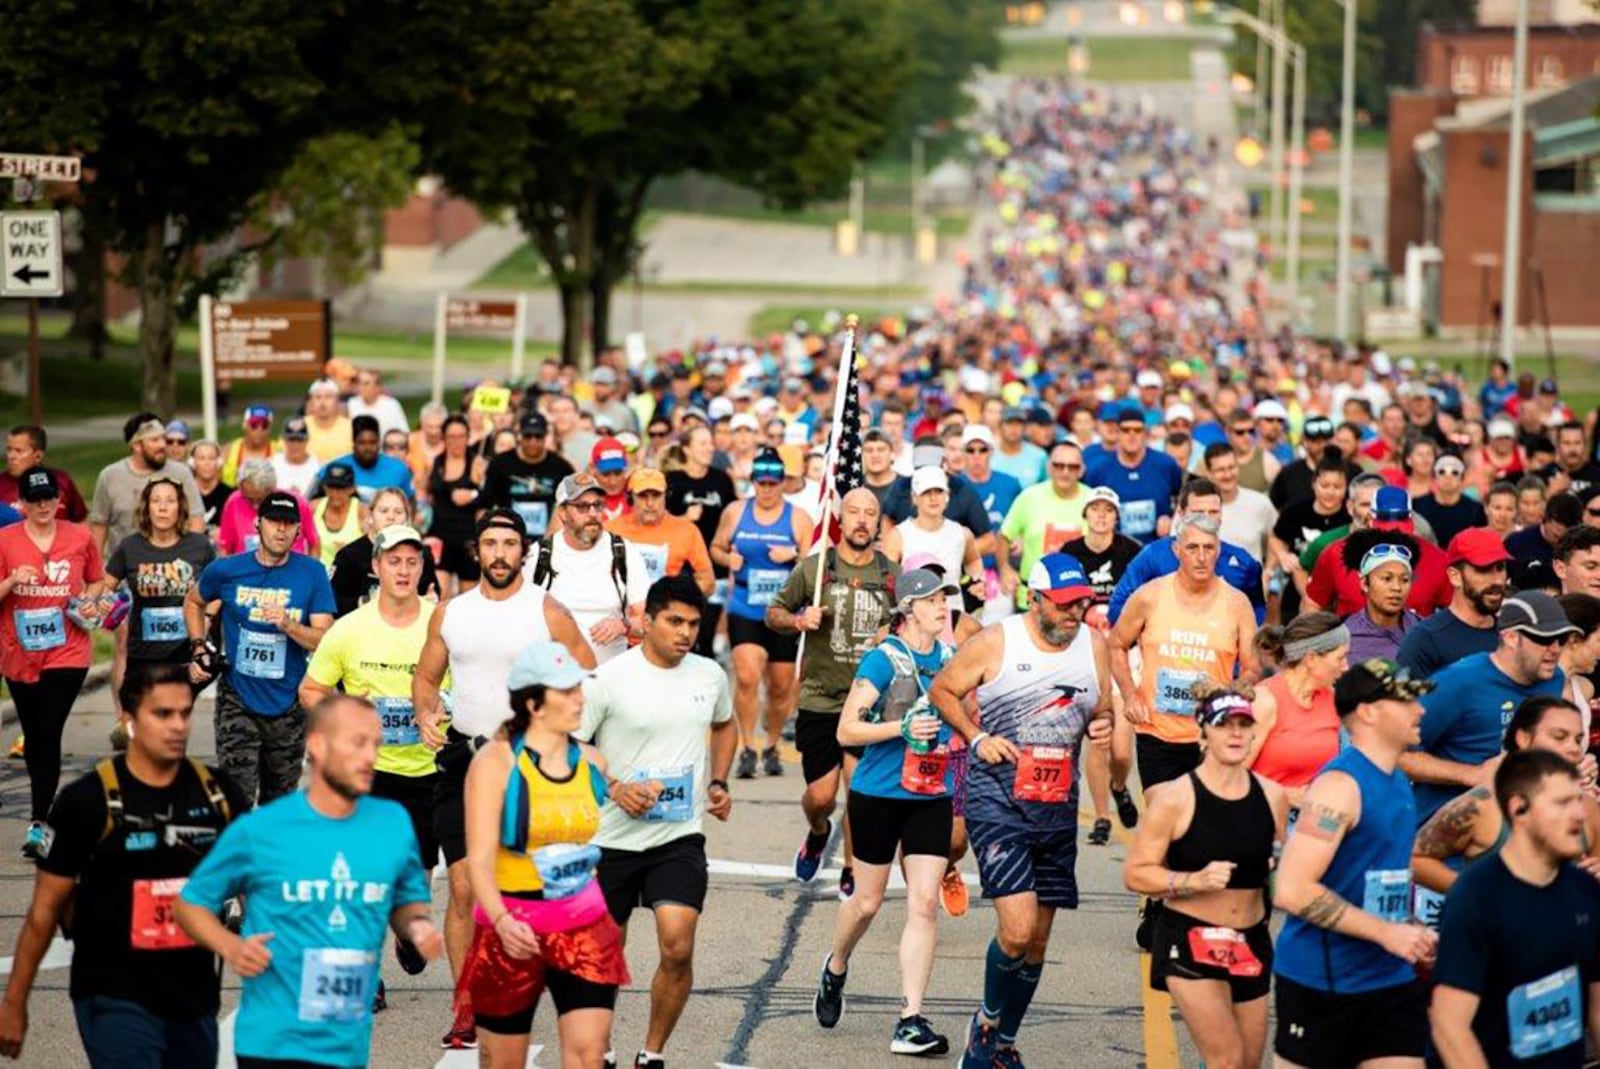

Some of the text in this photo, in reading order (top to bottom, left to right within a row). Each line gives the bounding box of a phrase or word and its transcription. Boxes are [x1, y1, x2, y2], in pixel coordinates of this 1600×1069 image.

[0, 157, 77, 177] STREET
[9, 220, 48, 238] ONE
[9, 242, 50, 258] WAY
[138, 558, 193, 584] MIND
[26, 622, 56, 636] 1764
[1170, 629, 1208, 646] RUN
[245, 647, 275, 662] 1761
[1158, 644, 1216, 663] ALOHA
[1164, 685, 1194, 701] 386
[1033, 767, 1060, 782] 377
[282, 880, 330, 902] LET
[334, 880, 360, 902] IT
[316, 975, 363, 998] 2431
